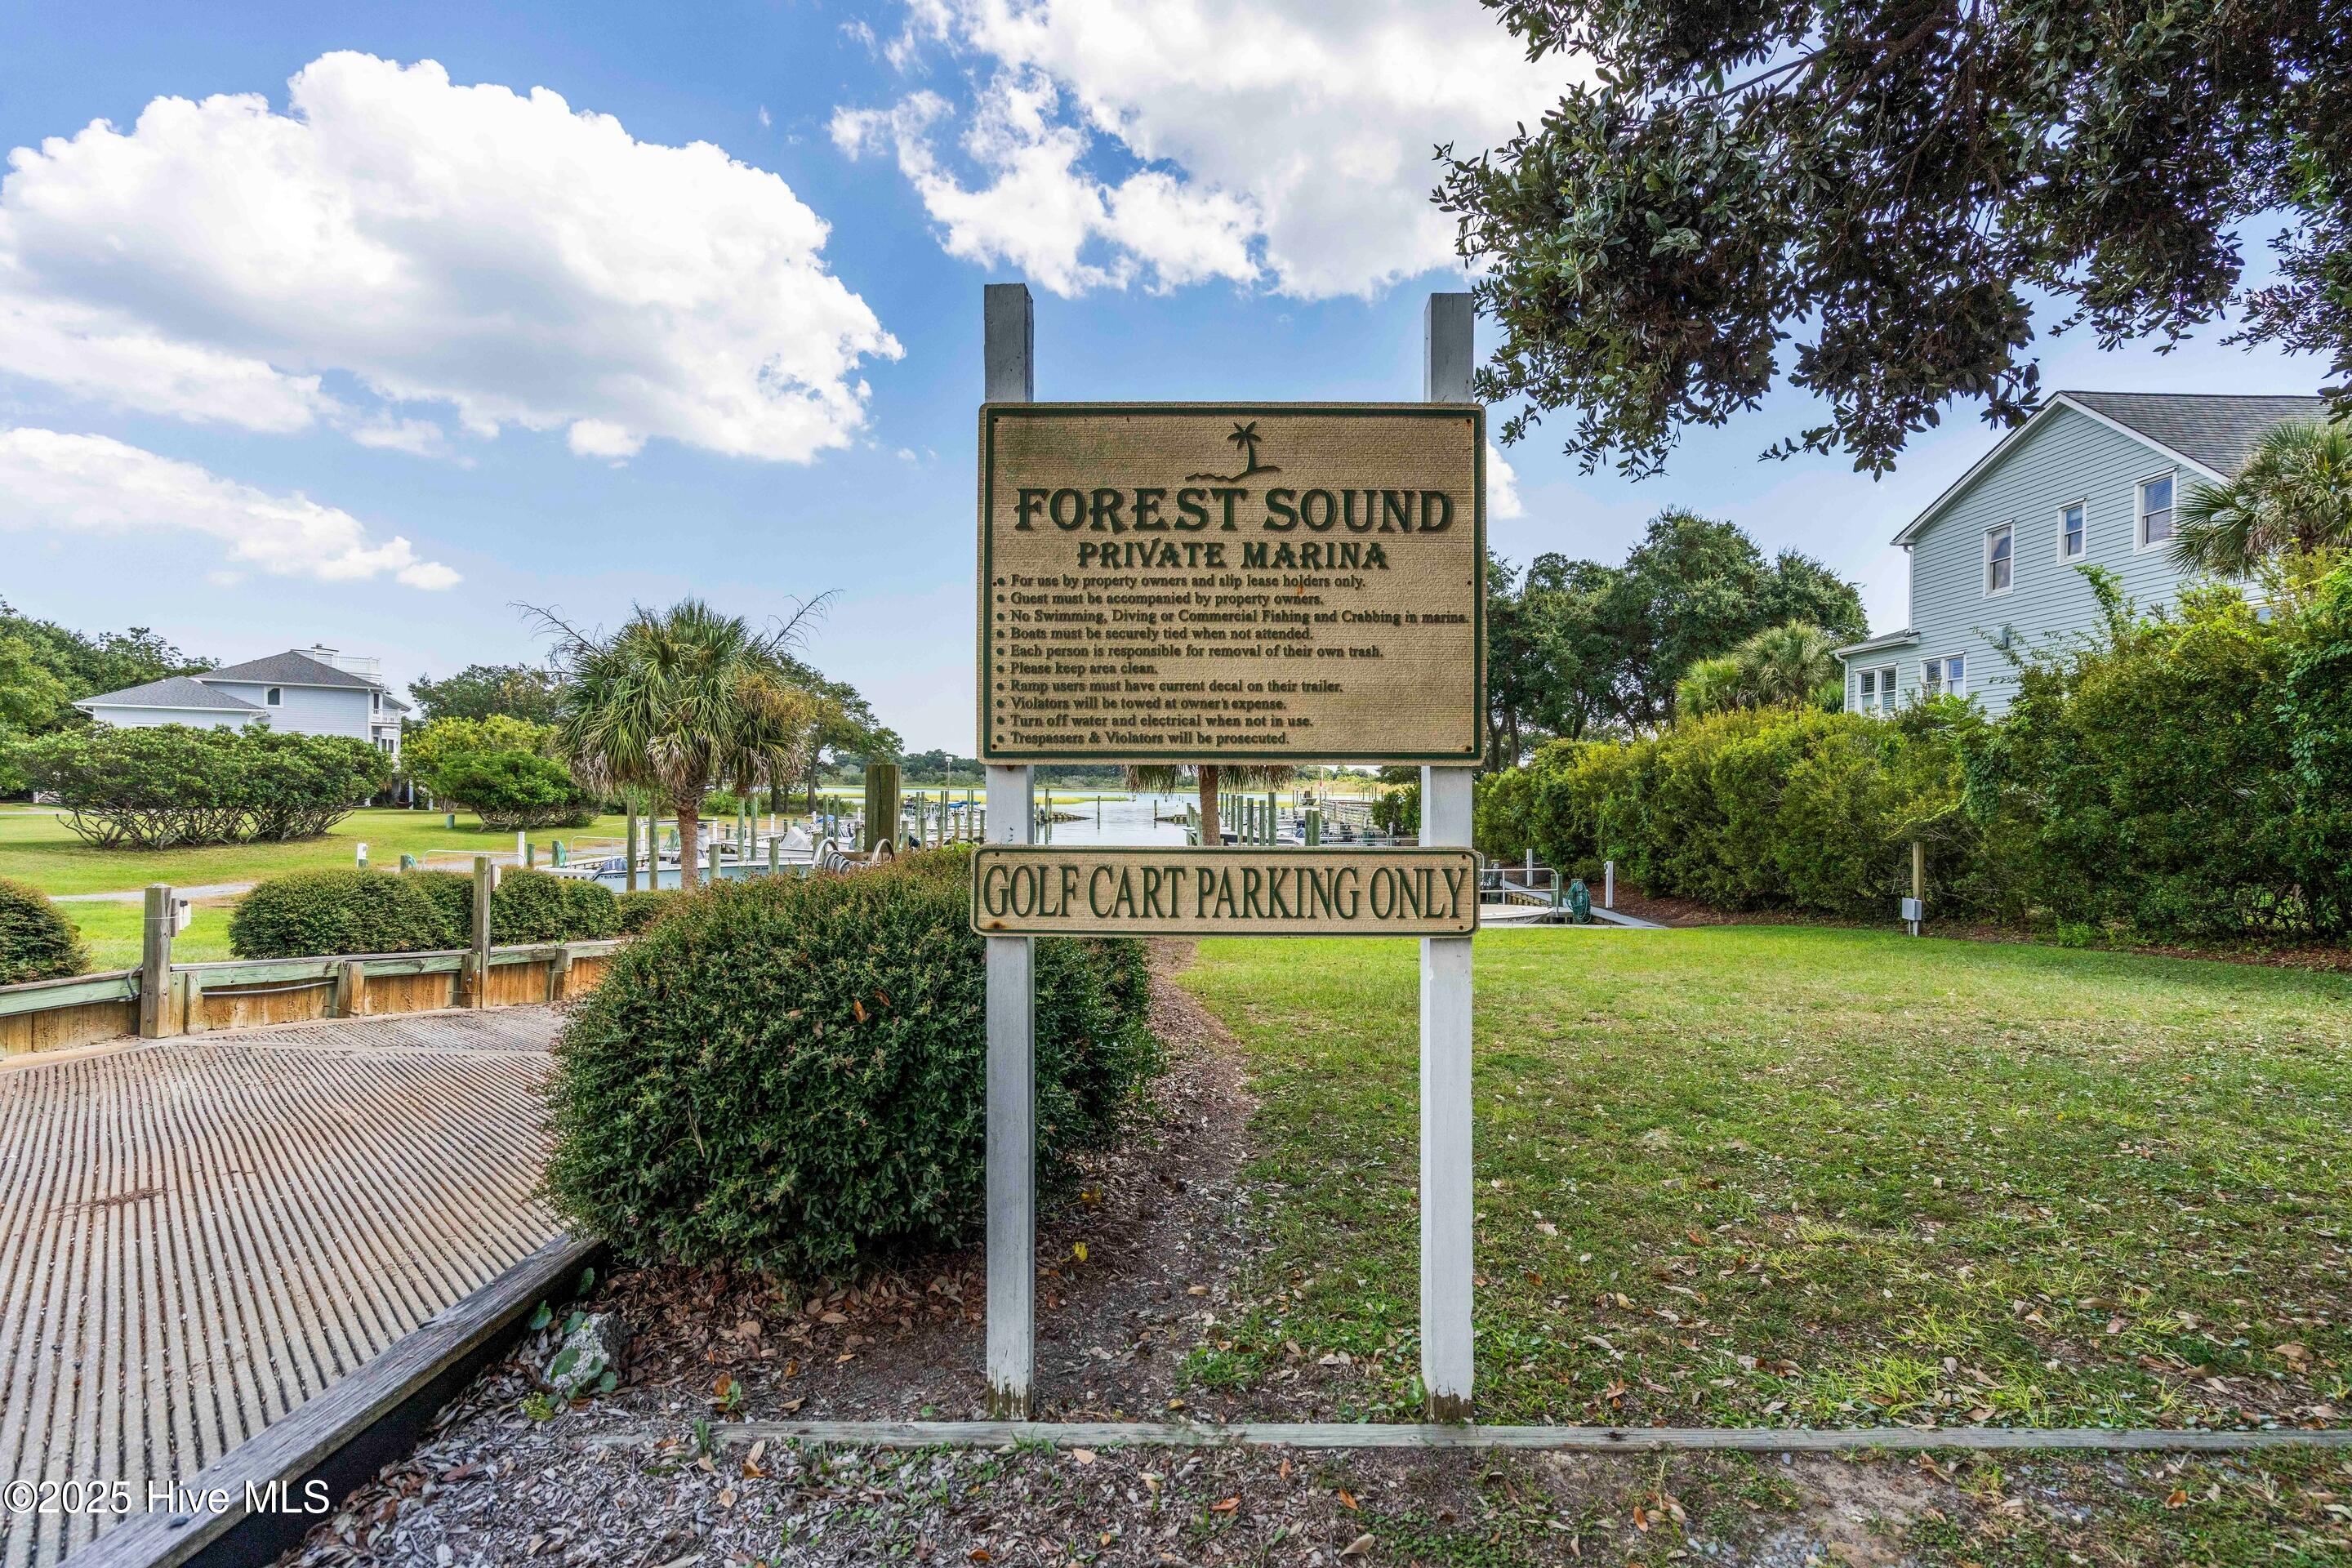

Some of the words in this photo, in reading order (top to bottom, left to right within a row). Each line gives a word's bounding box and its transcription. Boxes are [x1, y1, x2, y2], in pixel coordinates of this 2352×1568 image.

[1013, 488, 1250, 535] FOREST
[1263, 488, 1454, 533] SOUND
[1076, 537, 1227, 570] PRIVATE
[1241, 542, 1389, 571] MARINA
[1011, 574, 1033, 586] For
[1037, 577, 1058, 586] use
[1063, 574, 1078, 589] by
[1083, 577, 1138, 589] property
[1142, 577, 1187, 586] owners
[1192, 574, 1214, 586] and
[1218, 574, 1241, 590] slip
[1247, 574, 1278, 586] lease
[1283, 574, 1330, 587] holders
[1334, 574, 1365, 590] only.
[1011, 593, 1048, 604] Guest
[1053, 593, 1083, 604] must
[1088, 592, 1102, 604] be
[1107, 592, 1190, 607] accompanied
[1195, 592, 1211, 607] by
[1215, 593, 1270, 607] property
[1274, 595, 1323, 605] owners.
[1010, 610, 1030, 621] No
[1035, 610, 1107, 624] Swimming,
[1112, 610, 1156, 623] Diving
[1160, 613, 1174, 622] or
[1178, 610, 1258, 623] Commercial
[1262, 611, 1310, 624] Fishing
[1314, 611, 1338, 622] and
[1342, 611, 1401, 626] Crabbing
[1405, 611, 1417, 622] in
[1422, 612, 1468, 623] marina.
[1011, 628, 1046, 639] Boats
[1051, 629, 1082, 639] must
[1086, 627, 1101, 639] be
[1106, 628, 1158, 641] securely
[1163, 627, 1187, 639] tied
[1192, 628, 1225, 639] when
[1231, 629, 1251, 639] not
[1255, 628, 1312, 639] attended.
[1011, 645, 1041, 657] Each
[1045, 648, 1088, 659] person
[1093, 645, 1103, 657] is
[1108, 644, 1182, 659] responsible
[1185, 644, 1205, 657] for
[1208, 644, 1261, 657] removal
[1265, 645, 1280, 657] of
[1284, 645, 1312, 657] their
[1316, 648, 1344, 657] own
[1348, 646, 1383, 657] trash.
[1010, 663, 1051, 674] Please
[1056, 663, 1085, 676] keep
[1089, 666, 1116, 674] area
[1120, 663, 1157, 675] clean.
[1010, 680, 1048, 693] Ramp
[1053, 683, 1085, 692] users
[1089, 681, 1120, 692] must
[1125, 679, 1154, 692] have
[1159, 680, 1205, 692] current
[1209, 679, 1242, 692] decal
[1247, 683, 1263, 692] on
[1267, 679, 1297, 692] their
[1302, 680, 1343, 693] trailer.
[1011, 697, 1069, 709] Violators
[1073, 697, 1098, 709] will
[1102, 697, 1117, 709] be
[1120, 697, 1160, 709] towed
[1165, 698, 1177, 709] at
[1181, 698, 1228, 709] owner's
[1232, 700, 1286, 712] expense.
[1010, 715, 1043, 726] Turn
[1046, 714, 1068, 726] off
[1071, 716, 1107, 726] water
[1111, 715, 1136, 726] and
[1140, 715, 1200, 726] electrical
[1205, 715, 1241, 727] when
[1245, 716, 1266, 727] not
[1271, 715, 1283, 727] in
[1287, 718, 1313, 727] use.
[1011, 732, 1084, 746] Trespassers
[1089, 733, 1101, 743] &
[1106, 732, 1164, 744] Violators
[1168, 732, 1192, 744] will
[1197, 732, 1212, 744] be
[1216, 733, 1290, 746] prosecuted.
[982, 865, 1079, 919] GOLF
[1089, 865, 1187, 920] CART
[1195, 867, 1360, 920] PARKING
[1370, 867, 1469, 920] ONLY
